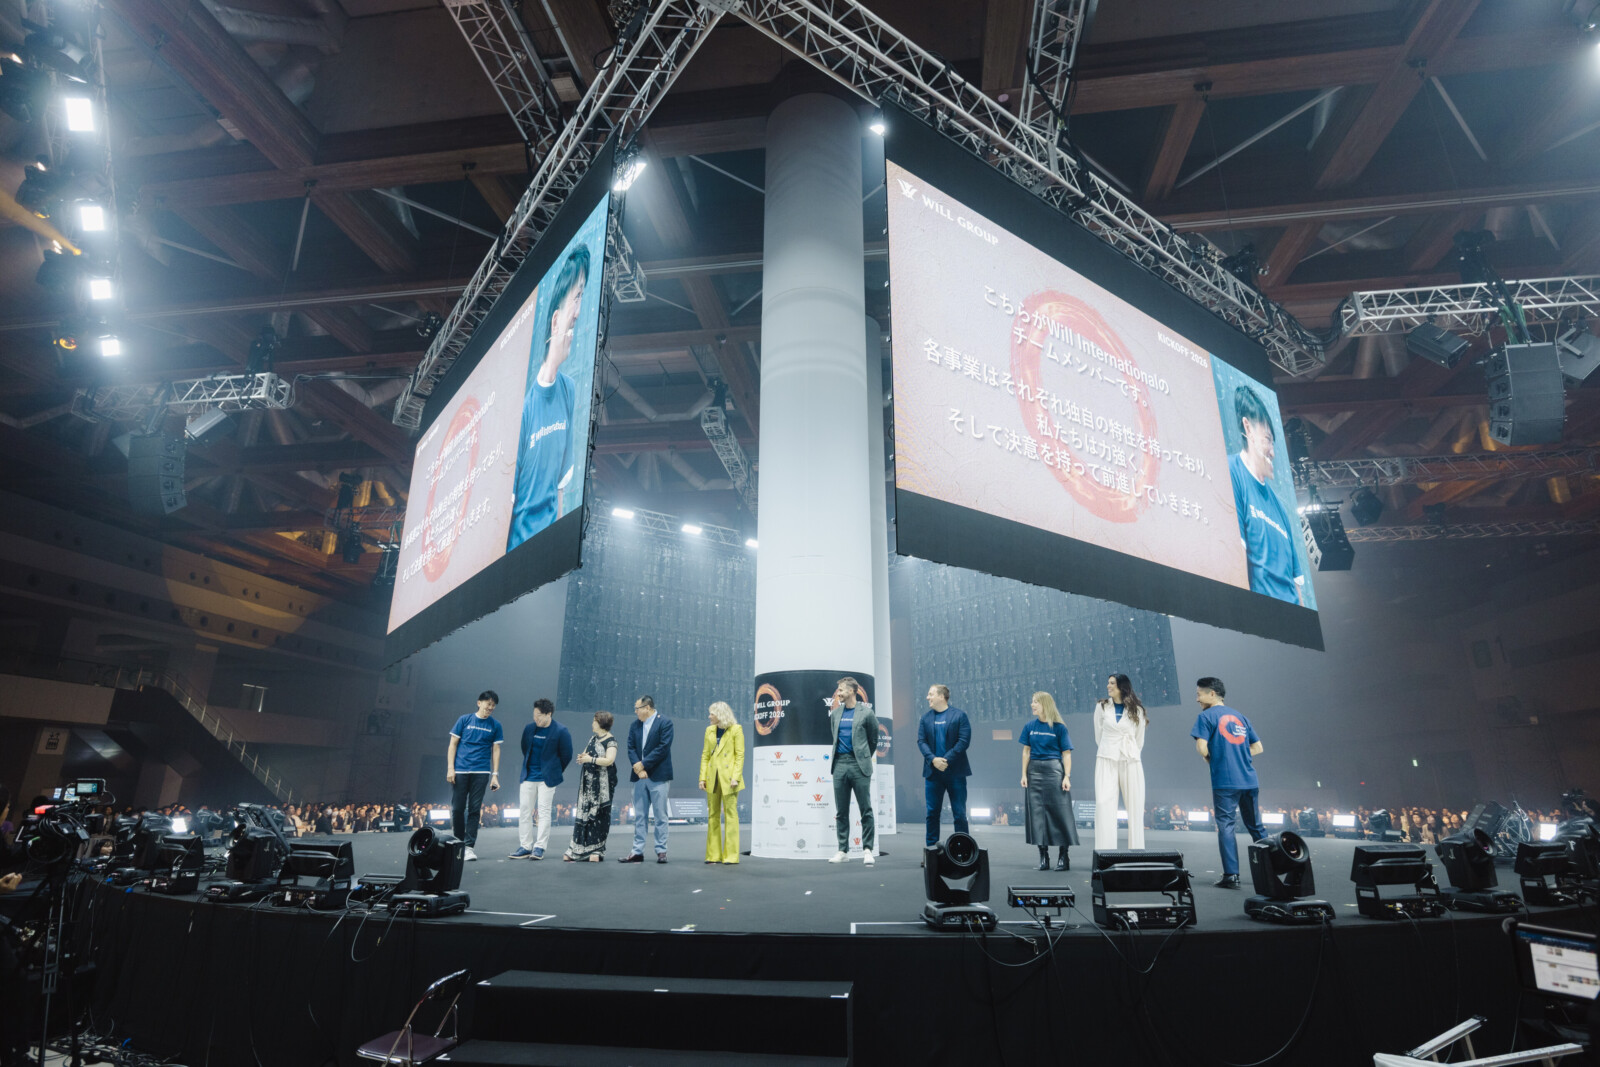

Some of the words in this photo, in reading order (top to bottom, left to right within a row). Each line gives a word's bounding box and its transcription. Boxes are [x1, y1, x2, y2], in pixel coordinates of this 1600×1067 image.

[921, 194, 954, 222] WILL
[957, 216, 999, 246] GROUP
[1013, 326, 1147, 408] チームメンバーです。
[1157, 331, 1189, 358] KICKOFF
[1190, 351, 1209, 369] 2026
[923, 338, 1212, 481] 各事業はそれぞれ独自の特性を持っており、
[948, 407, 1209, 524] そして決意を持って前進していきます。
[1036, 412, 1145, 476] 私たちは力強く、
[767, 699, 791, 708] GROUP
[769, 710, 785, 719] 2026
